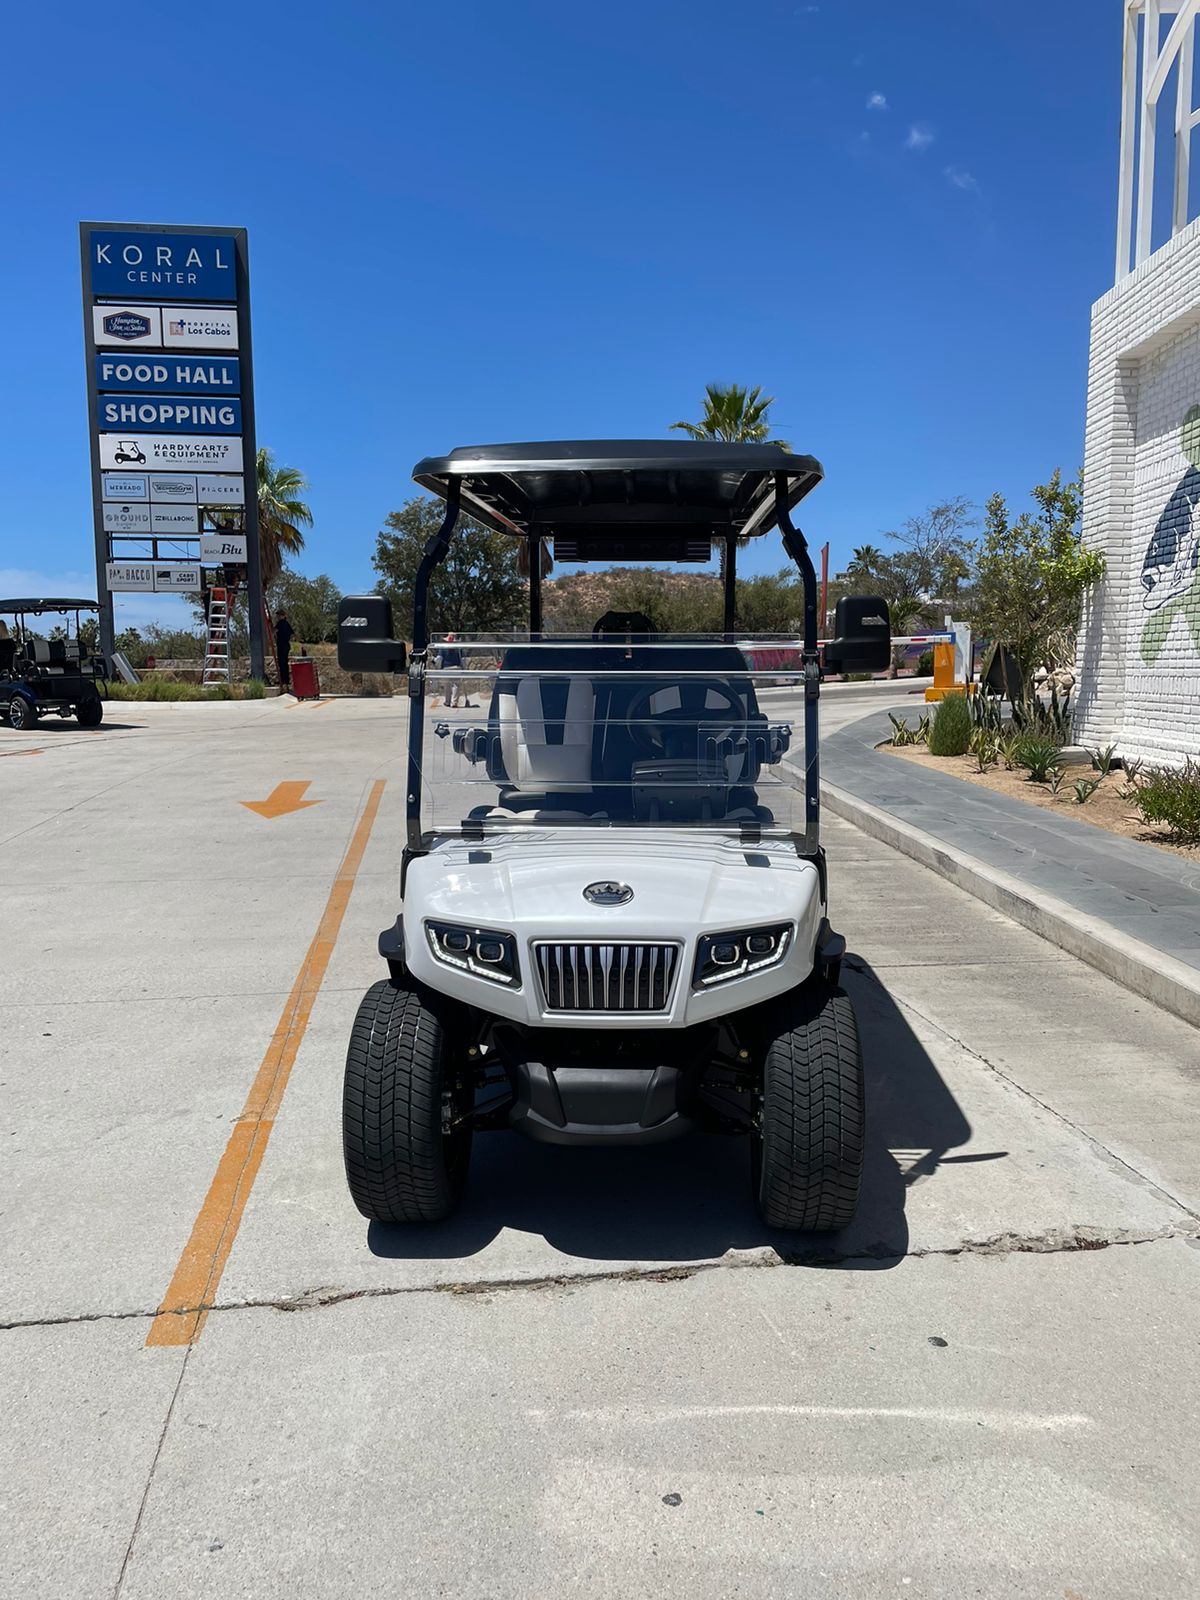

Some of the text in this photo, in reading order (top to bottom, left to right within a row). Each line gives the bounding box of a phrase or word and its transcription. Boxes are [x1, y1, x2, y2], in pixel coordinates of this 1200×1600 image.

[97, 244, 228, 269] KORAL
[127, 270, 197, 285] CENTER
[188, 327, 231, 336] Los Cabos
[102, 364, 233, 385] FOOD HALL
[105, 403, 235, 426] SHOPPING
[153, 443, 229, 452] HARDY CARTS
[162, 450, 226, 458] EQUIPMENT
[105, 514, 149, 522] GROUND
[220, 543, 243, 555] Blu
